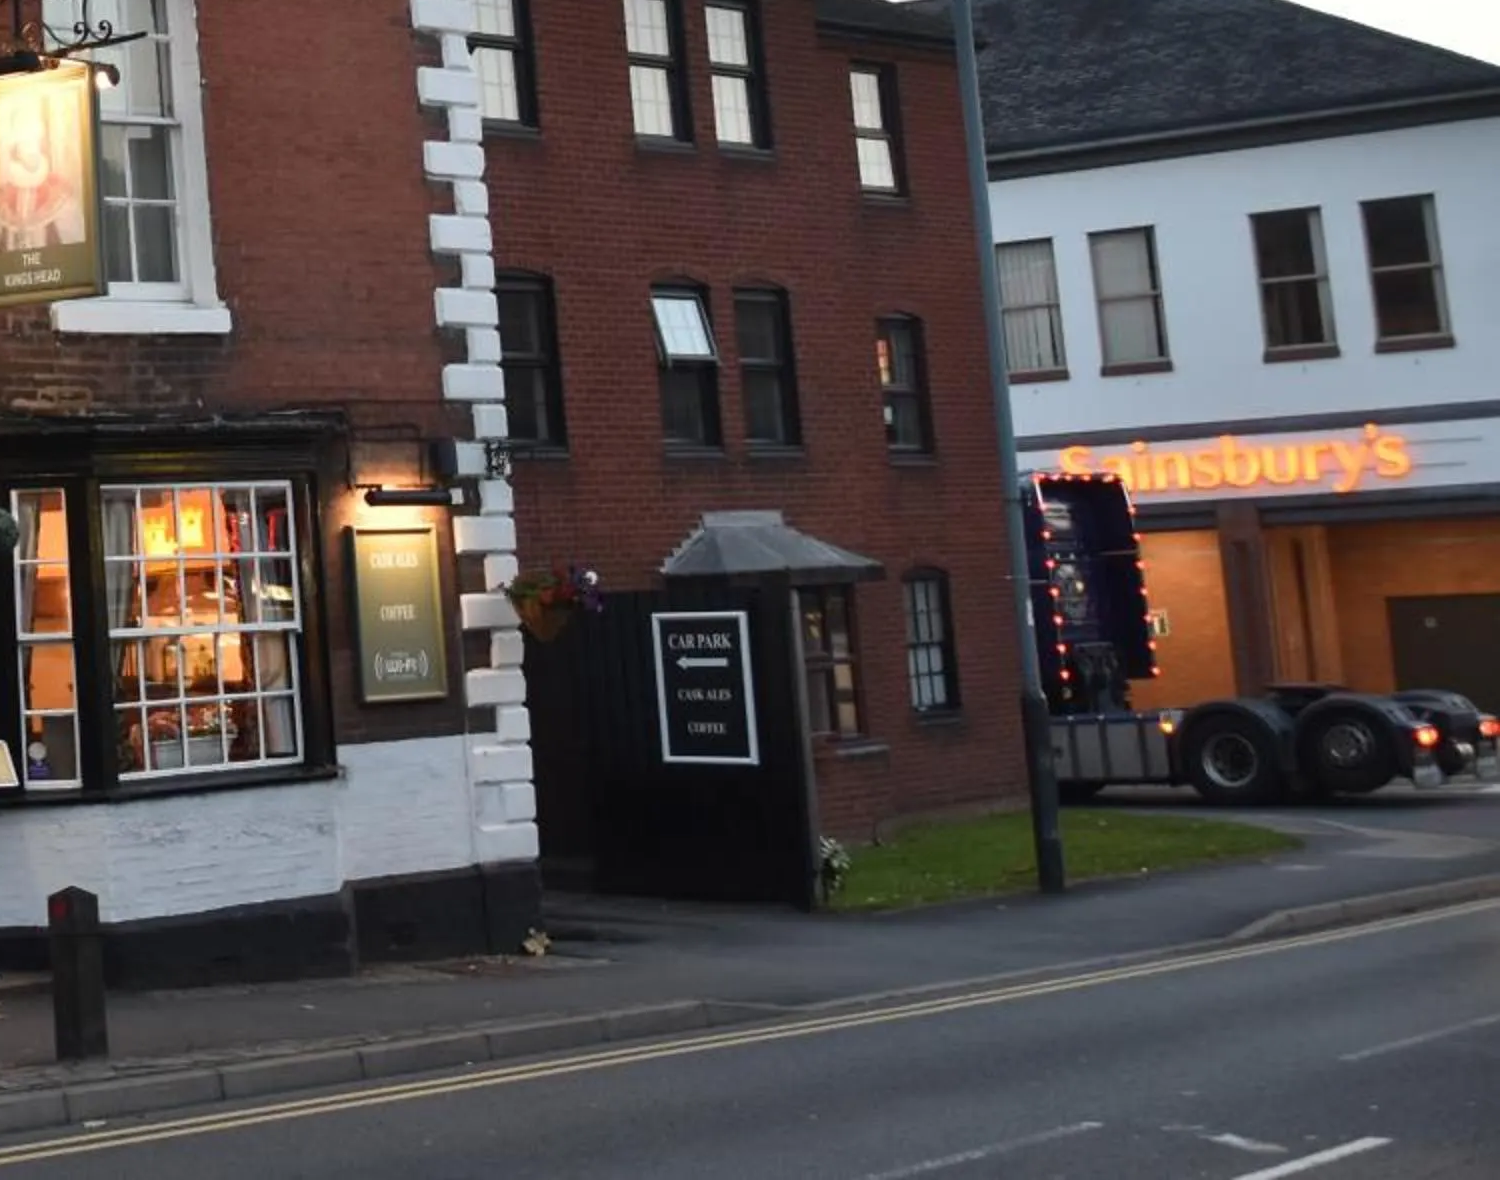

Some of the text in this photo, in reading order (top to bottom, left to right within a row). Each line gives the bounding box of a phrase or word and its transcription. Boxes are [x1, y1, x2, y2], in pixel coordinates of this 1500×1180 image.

[22, 251, 41, 267] THE
[667, 633, 733, 649] CAR PARK
[677, 688, 733, 701] CASK ALES
[687, 722, 728, 735] COFFEE
